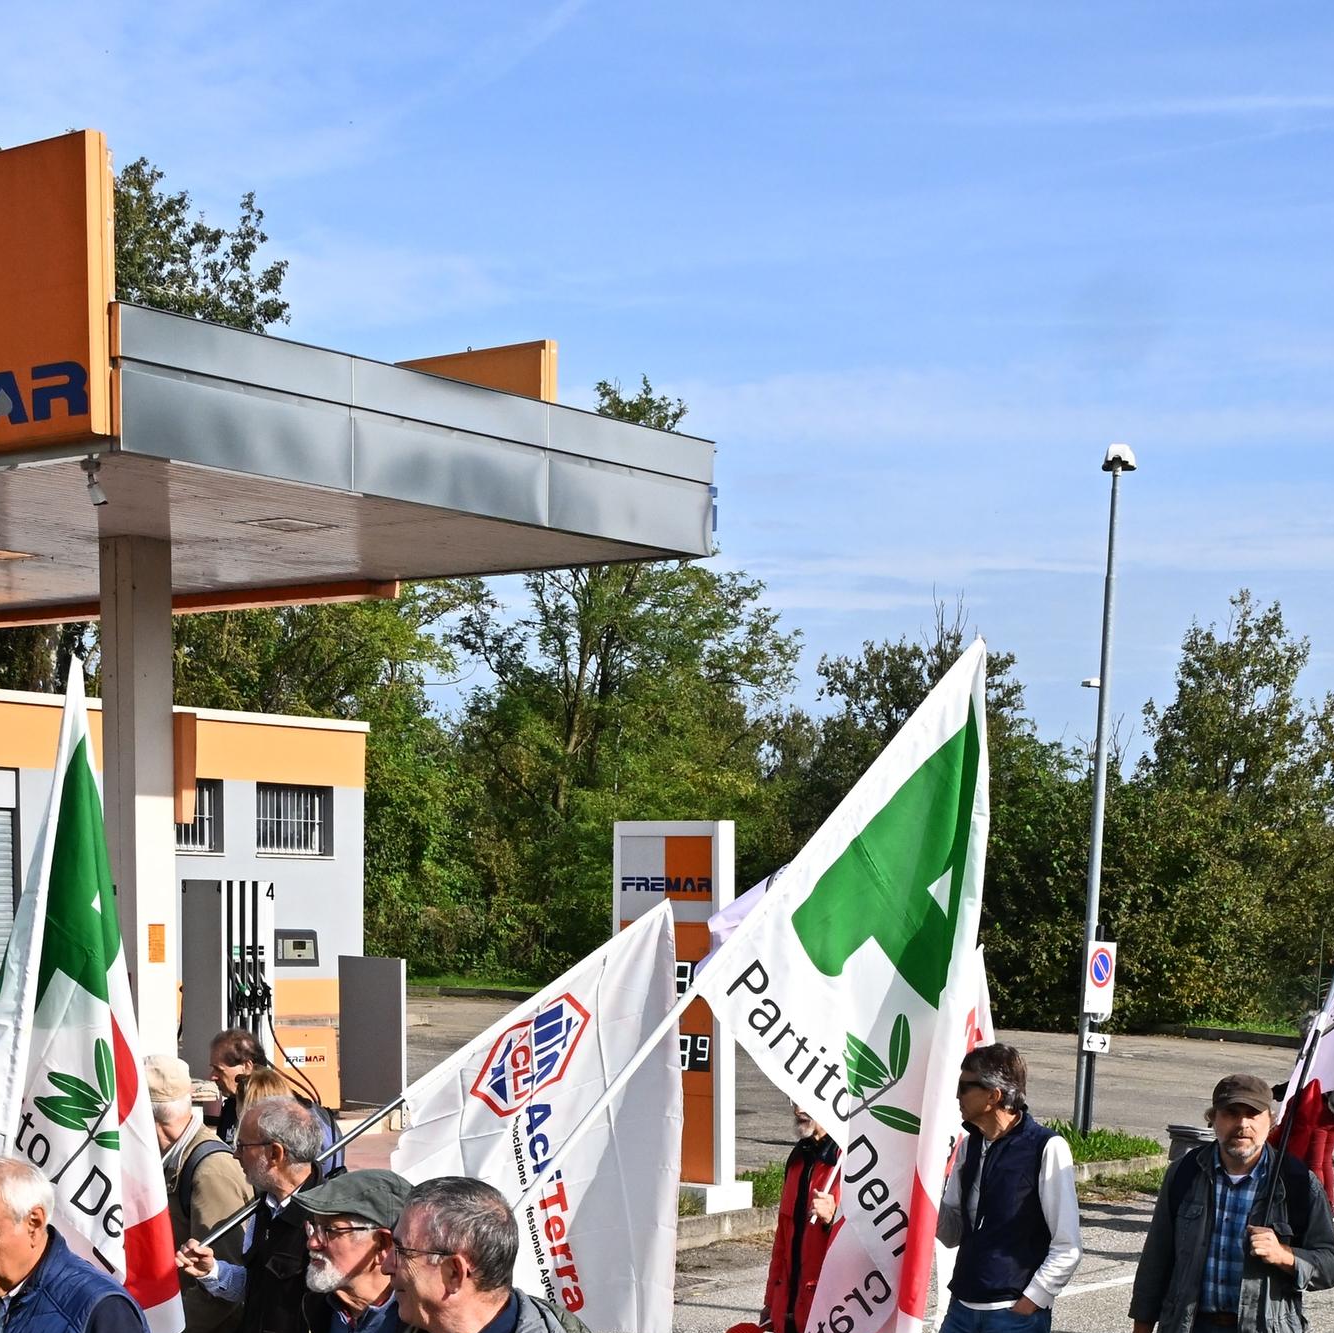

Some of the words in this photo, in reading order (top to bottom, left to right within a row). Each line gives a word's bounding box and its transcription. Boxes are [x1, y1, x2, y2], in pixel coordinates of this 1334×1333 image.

[266, 882, 274, 900] 4
[621, 876, 712, 892] FREMAR
[726, 958, 850, 1123] Partito
